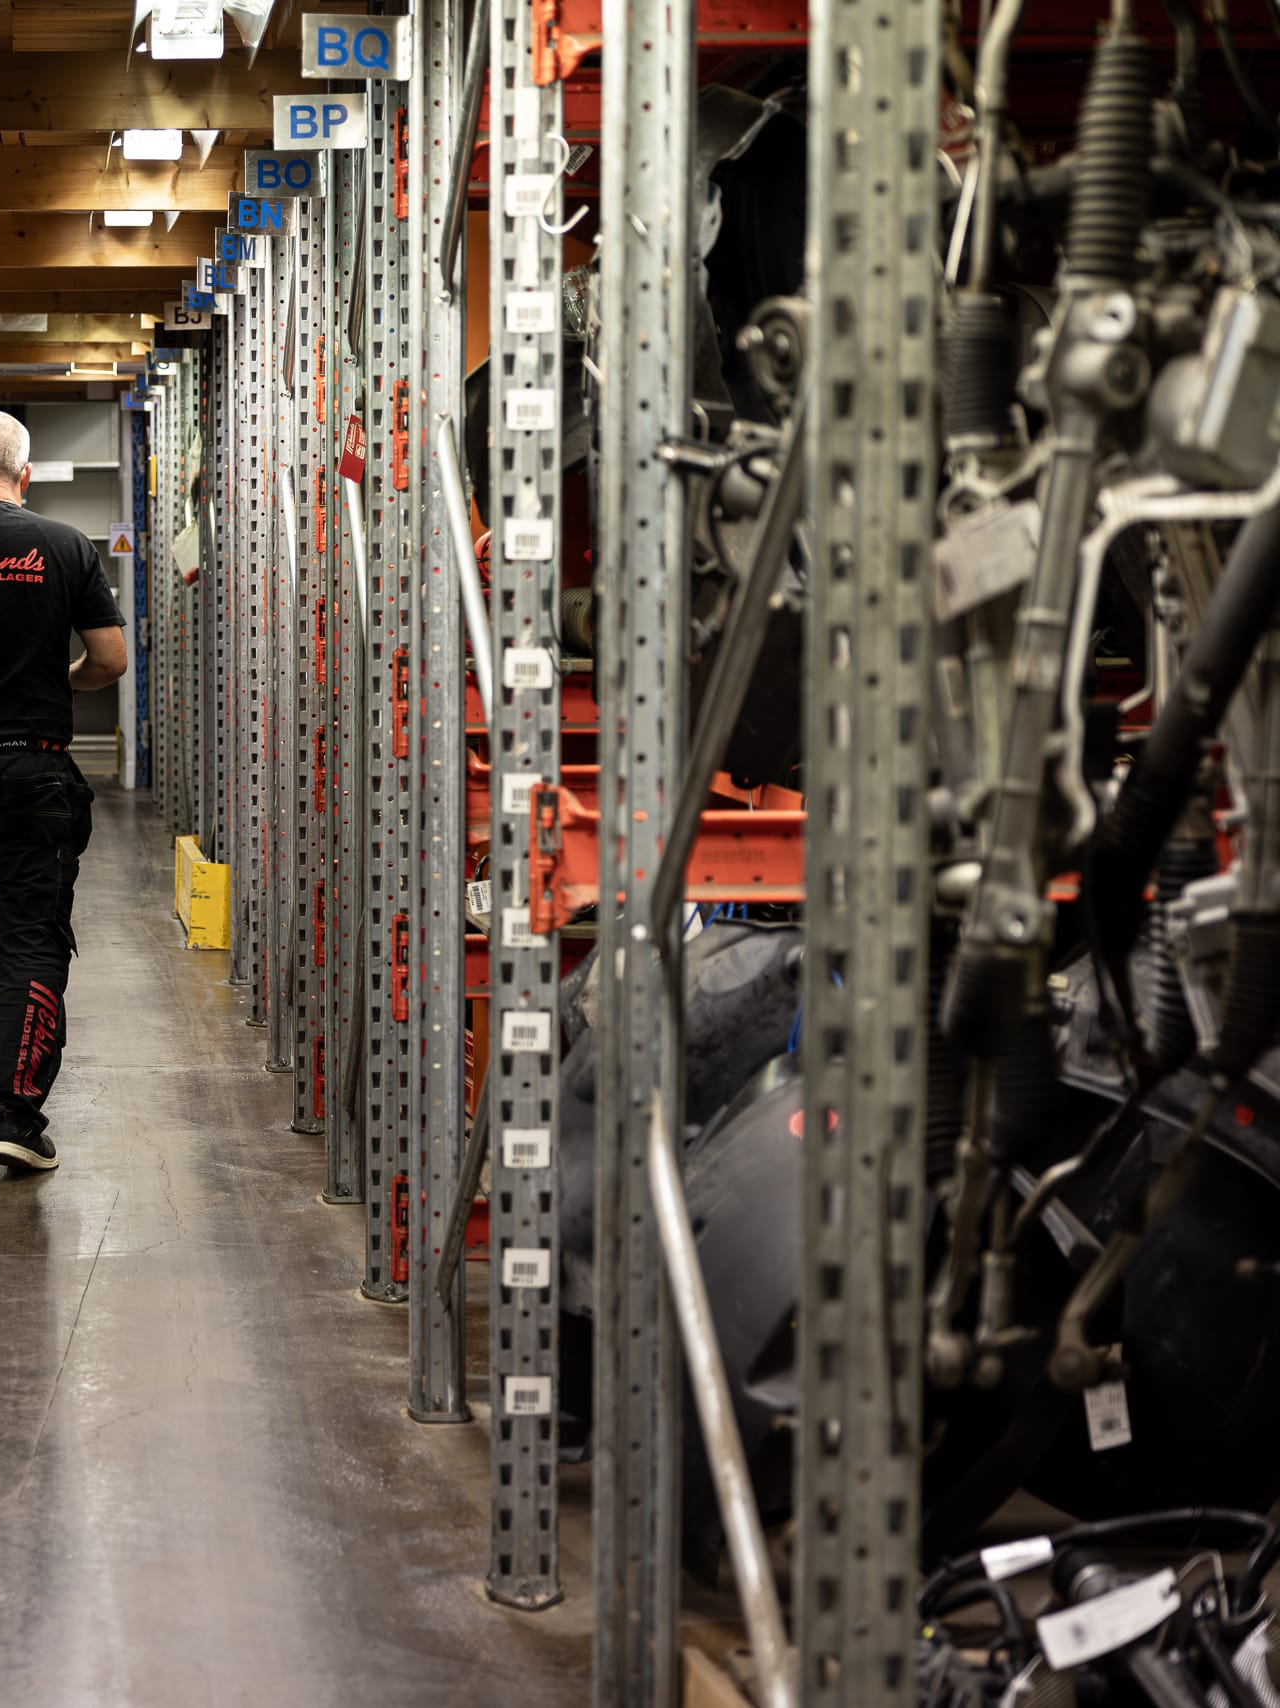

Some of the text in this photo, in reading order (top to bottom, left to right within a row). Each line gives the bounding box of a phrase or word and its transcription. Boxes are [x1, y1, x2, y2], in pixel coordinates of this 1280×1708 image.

[316, 26, 390, 70] BQ
[289, 104, 349, 139] BP
[257, 159, 312, 189] BO
[238, 200, 283, 229] BN
[221, 235, 257, 261] BM
[204, 265, 235, 289] BL
[174, 306, 202, 325] BJ
